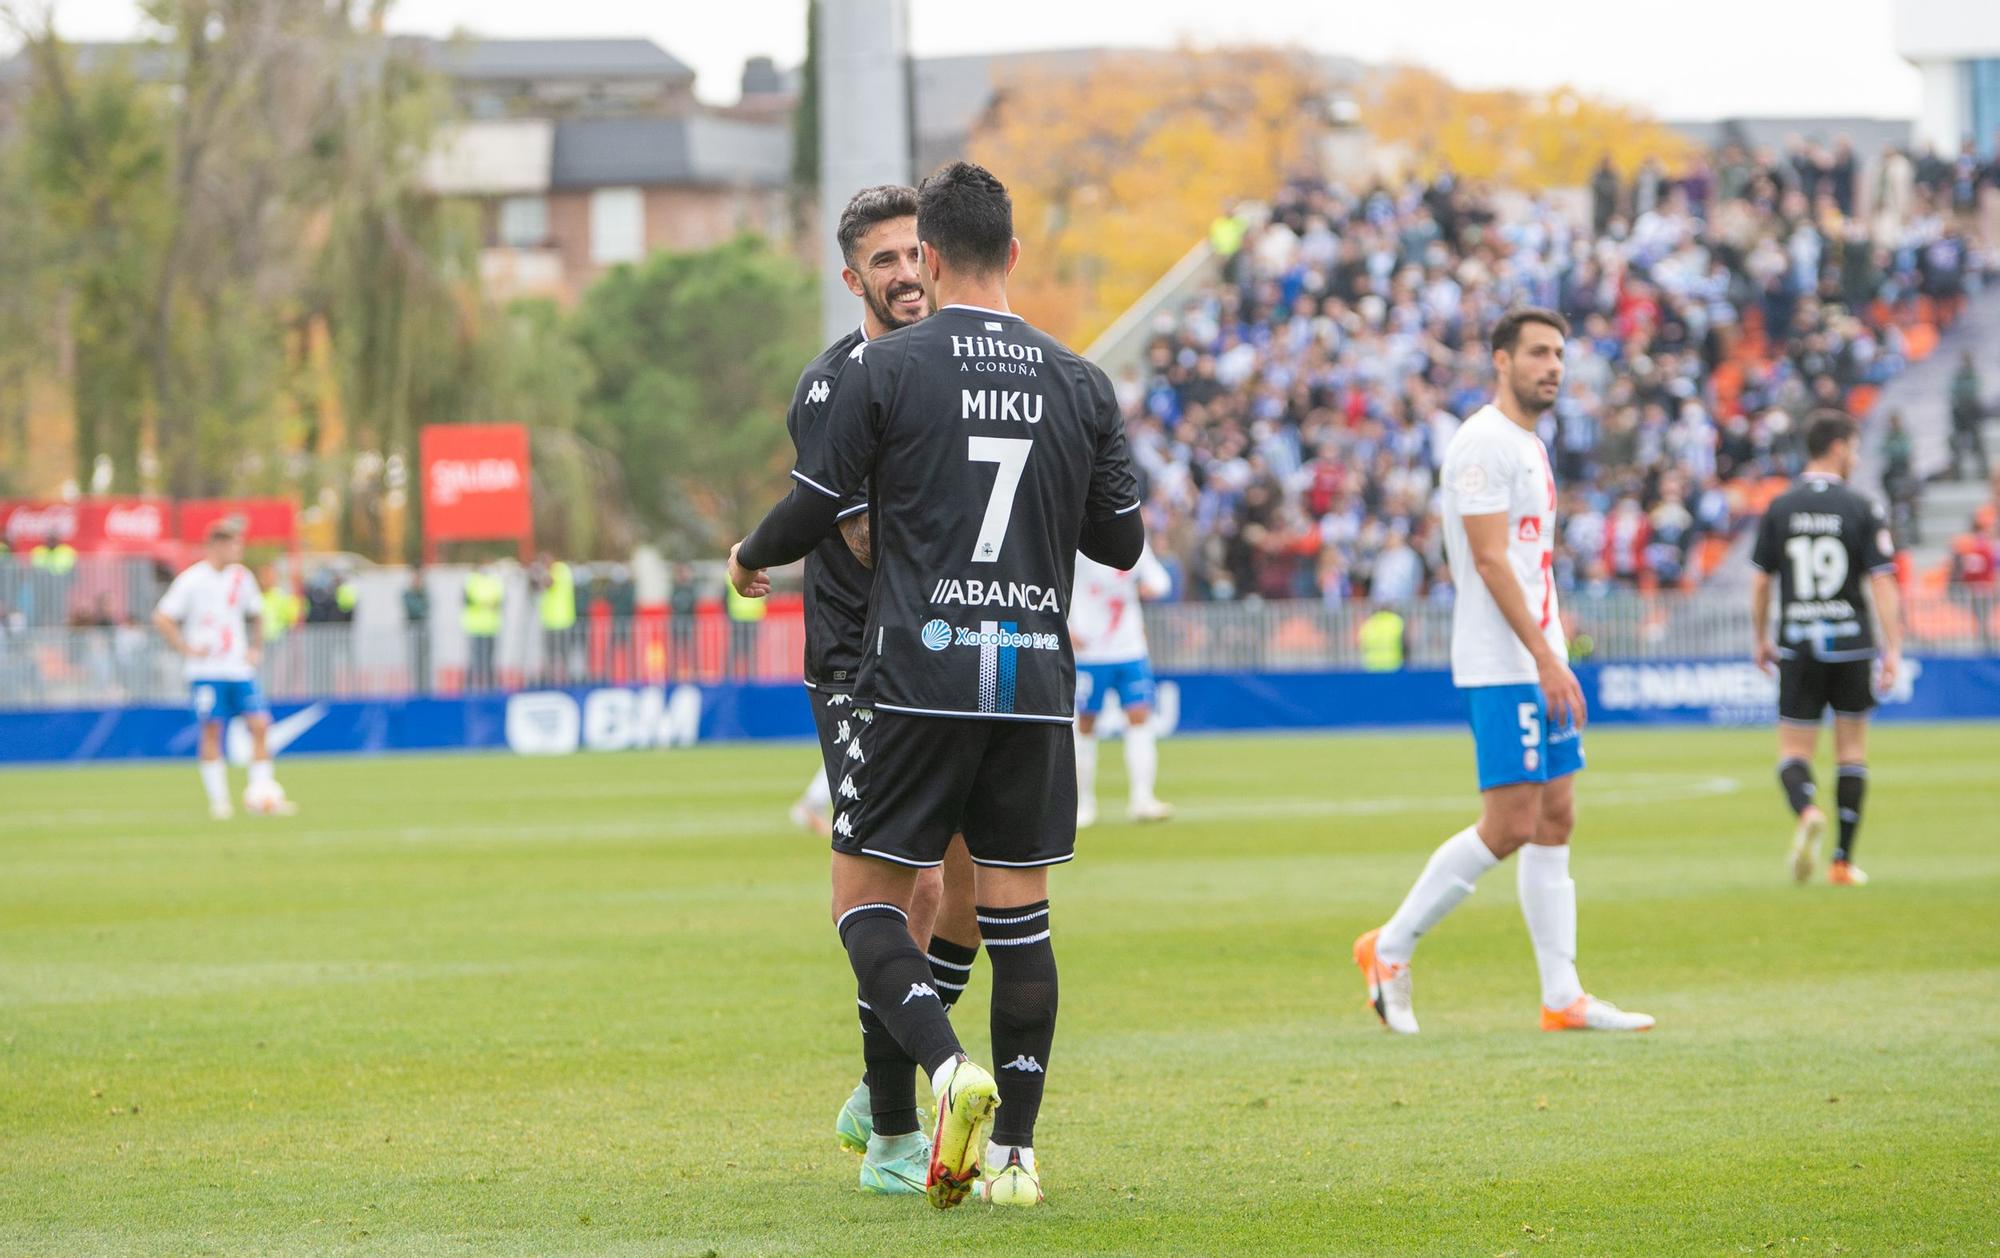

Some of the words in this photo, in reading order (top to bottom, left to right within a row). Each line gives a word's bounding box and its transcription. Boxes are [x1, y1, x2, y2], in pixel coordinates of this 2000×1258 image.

[951, 335, 1043, 363] Hilton
[960, 361, 969, 372] A
[975, 361, 1037, 377] CORUÑA
[962, 389, 1043, 424] MIKU
[968, 435, 1034, 563] 7
[1785, 535, 1849, 600] 19
[955, 626, 1033, 649] Xacobeo
[1518, 702, 1540, 748] 5
